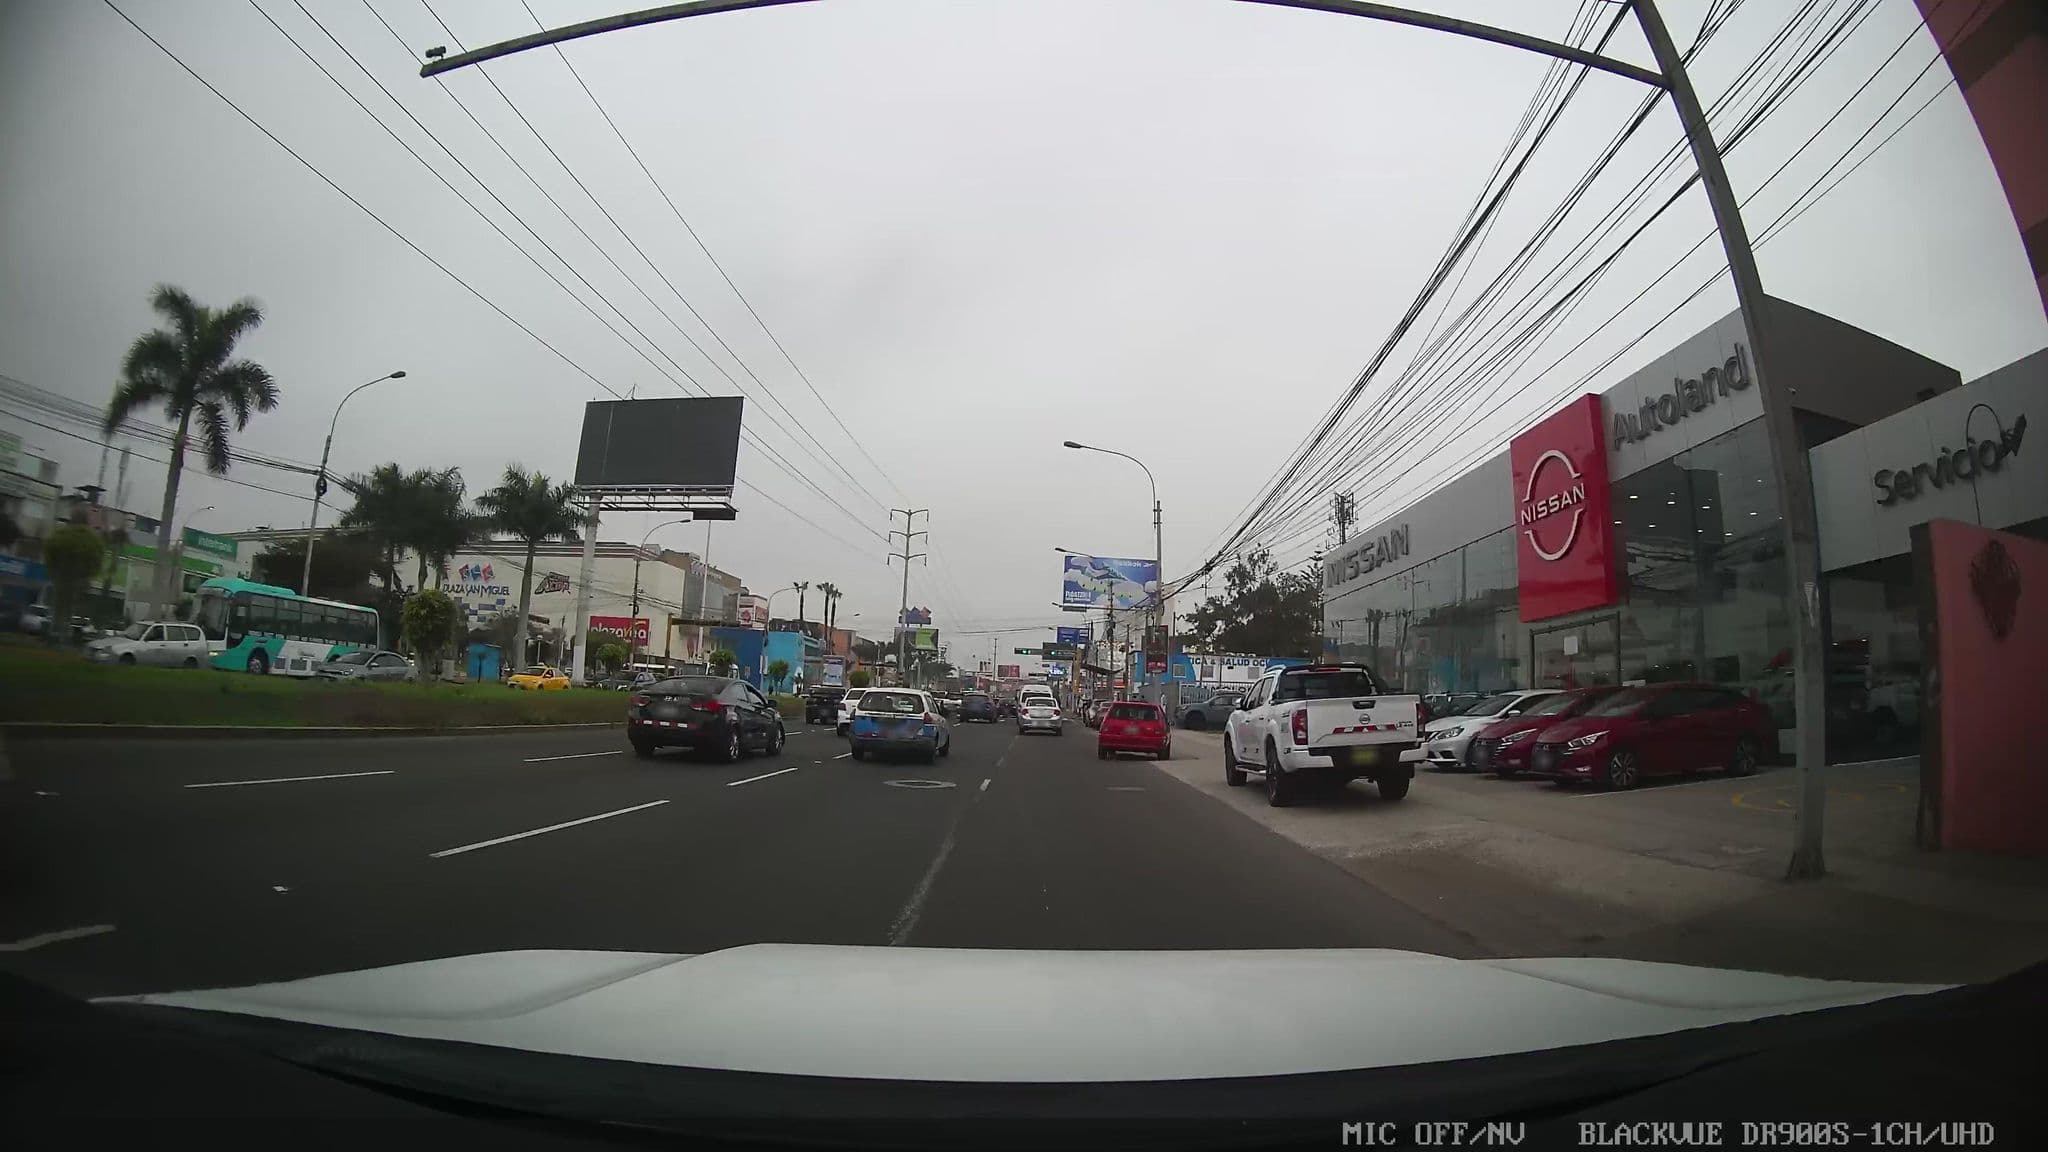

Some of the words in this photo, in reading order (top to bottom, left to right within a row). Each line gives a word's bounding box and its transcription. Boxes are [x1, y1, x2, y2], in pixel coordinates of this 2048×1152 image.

[1613, 342, 1751, 451] Autoland
[1521, 483, 1584, 526] NISSAN
[1326, 523, 1409, 588] NISSAN
[443, 584, 465, 594] PLAZA
[466, 584, 480, 596] SAN
[1220, 658, 1250, 666] SALUD
